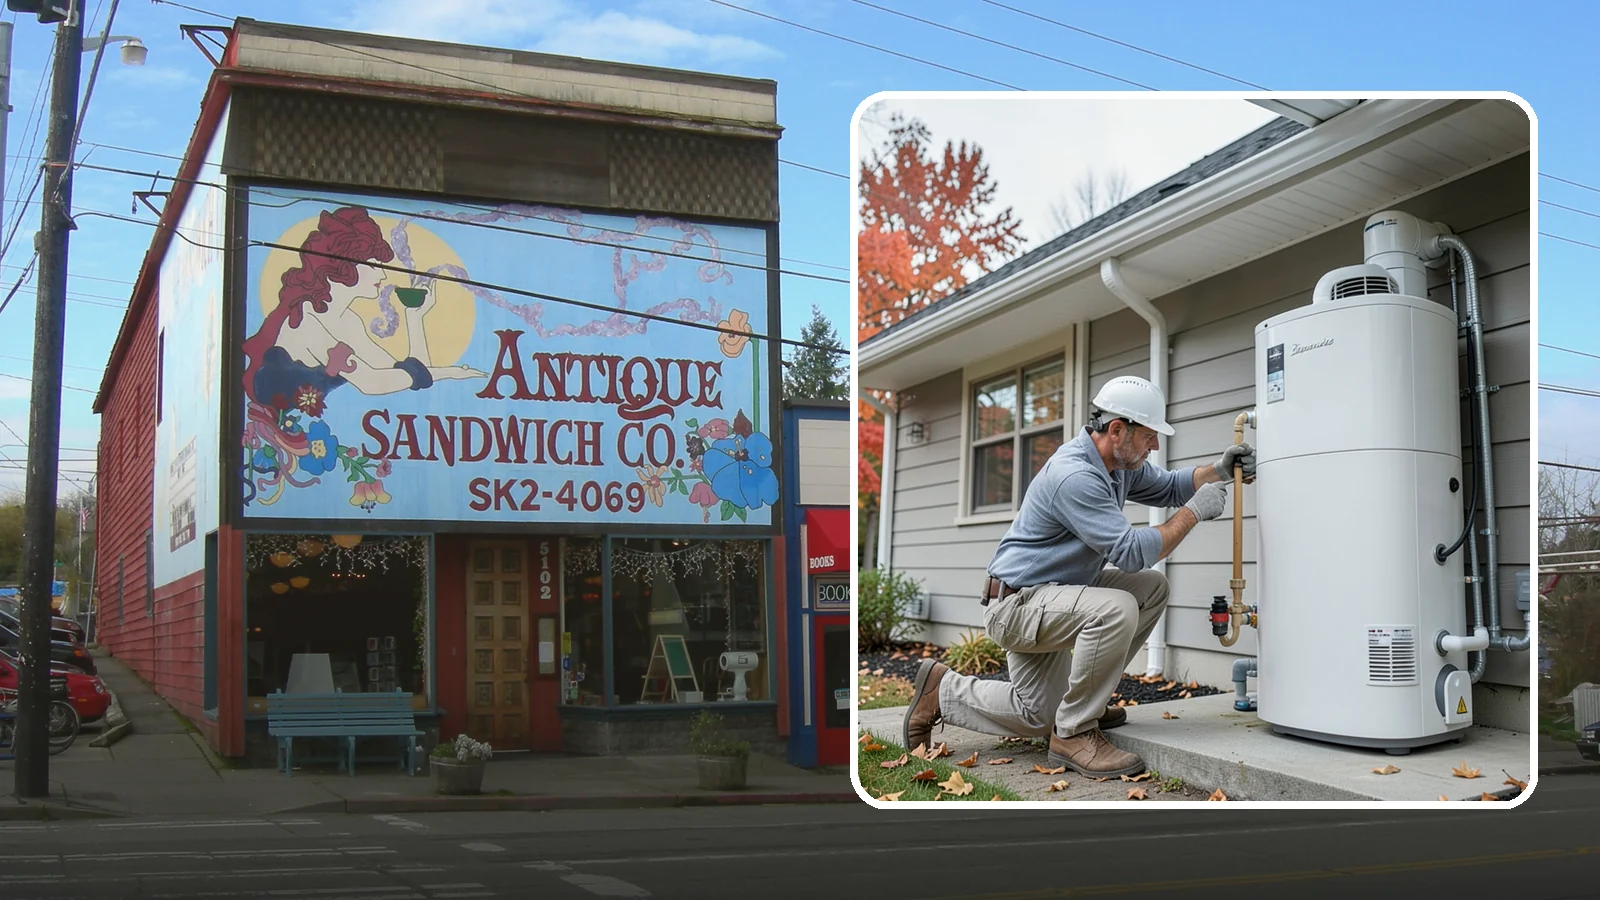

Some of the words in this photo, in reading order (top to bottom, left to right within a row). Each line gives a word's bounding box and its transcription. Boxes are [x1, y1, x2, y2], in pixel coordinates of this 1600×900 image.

[477, 329, 724, 421] ANTIQUE
[361, 409, 604, 468] SANDWICH
[617, 420, 686, 469] CO.
[468, 477, 646, 514] SK2-4069
[540, 541, 551, 600] 5102
[809, 555, 835, 569] BOOKS
